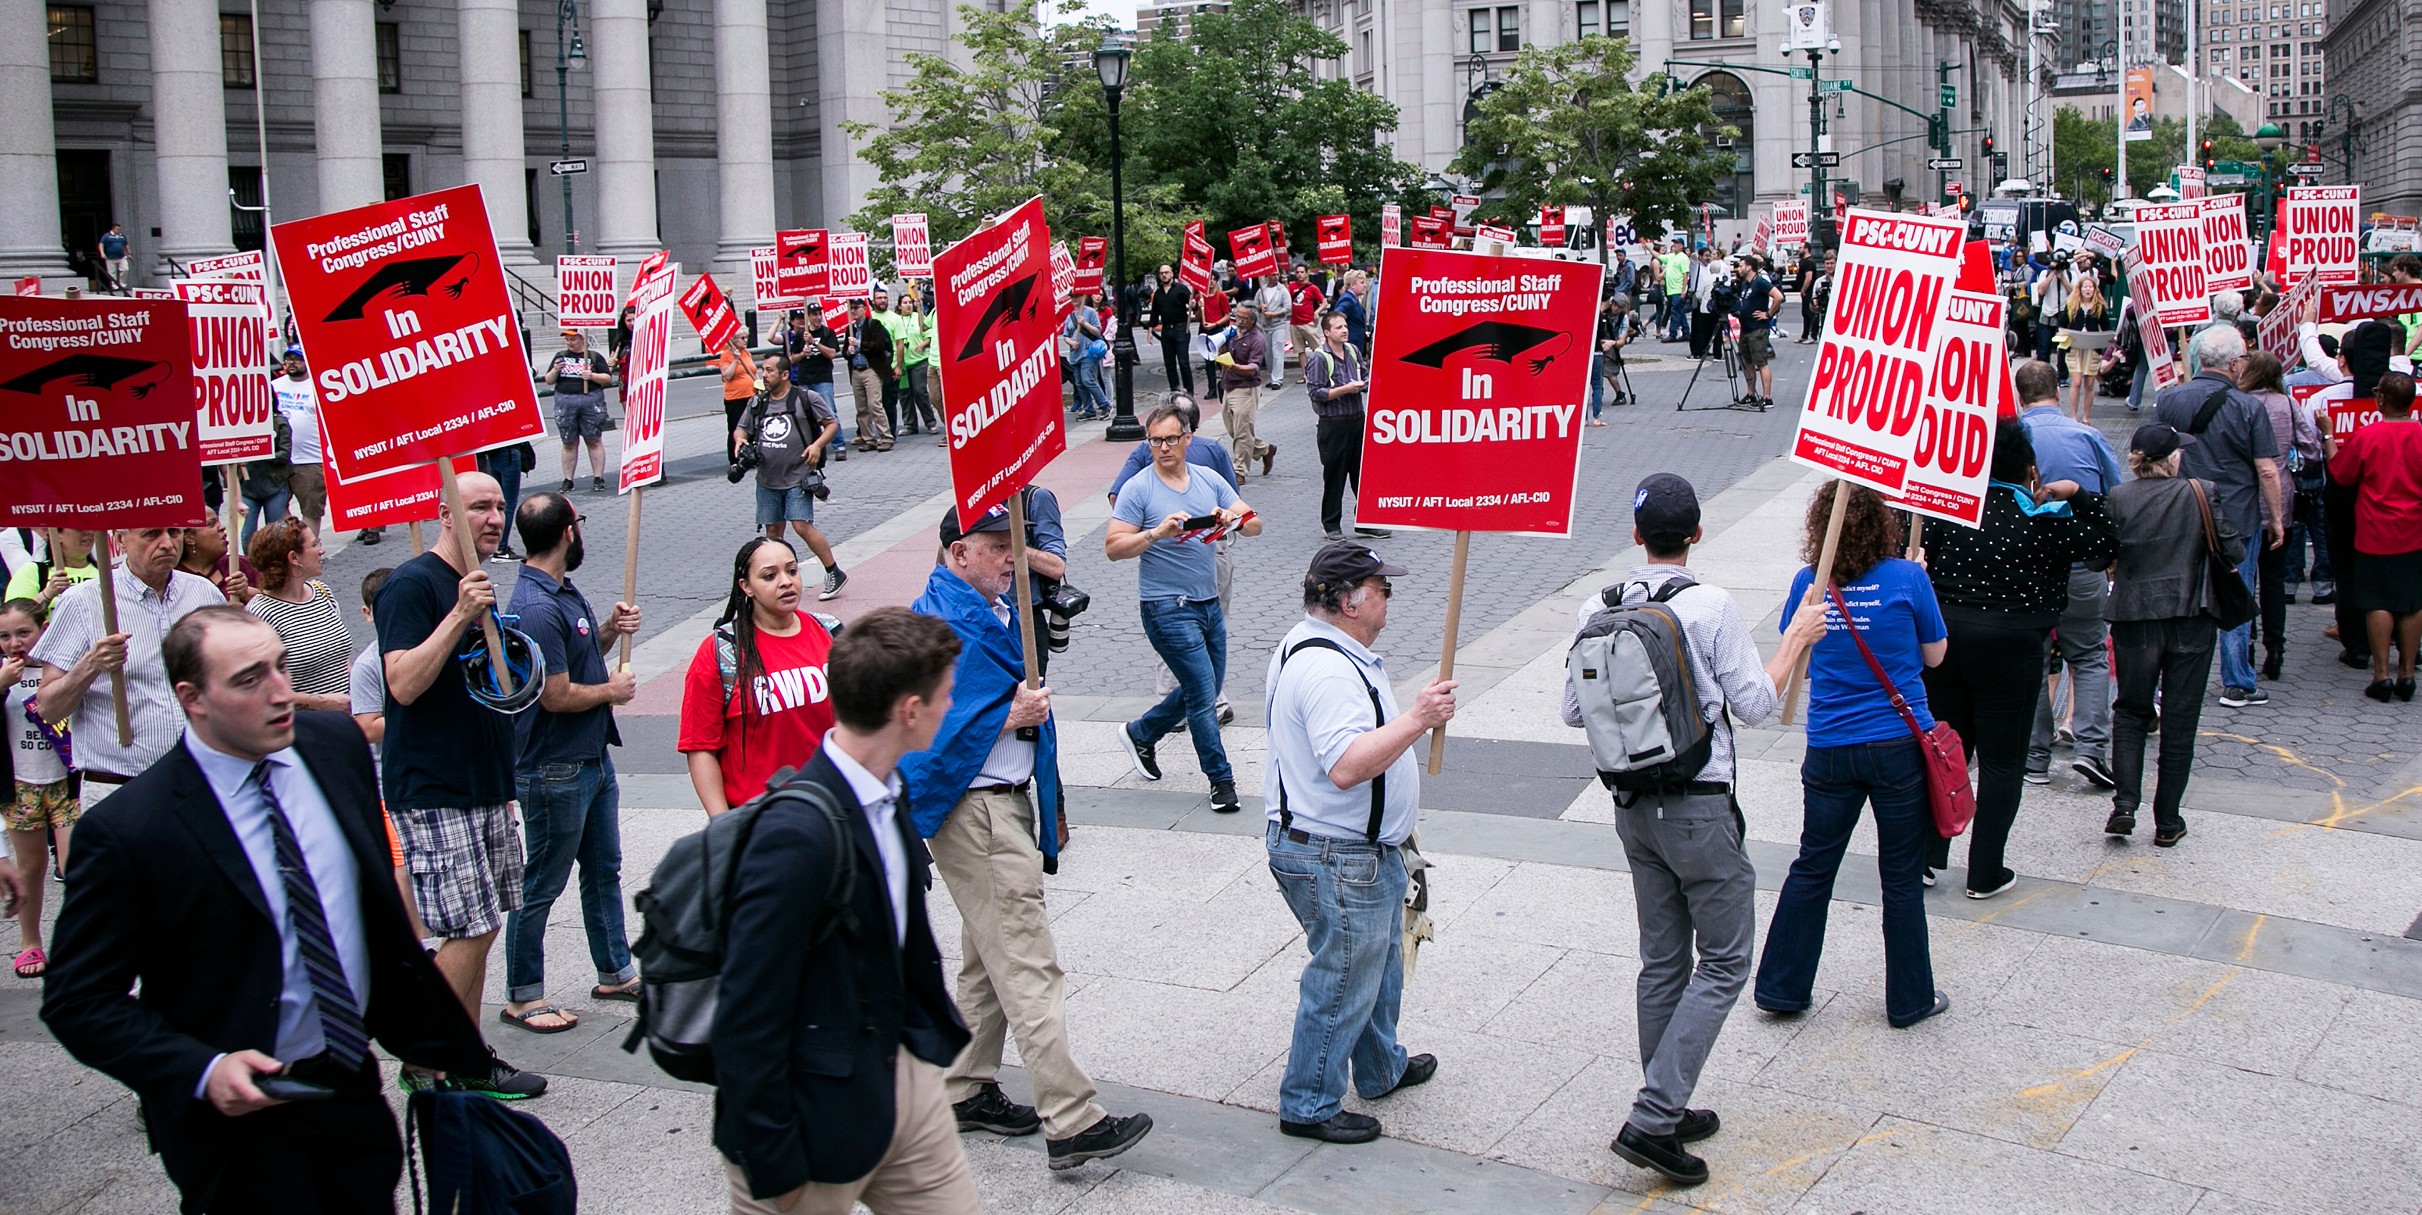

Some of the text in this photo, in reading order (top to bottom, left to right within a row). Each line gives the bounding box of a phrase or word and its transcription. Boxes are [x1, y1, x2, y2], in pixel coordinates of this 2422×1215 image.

[1790, 68, 1806, 78] CENTRE
[1821, 81, 1841, 91] DUANE
[2201, 197, 2238, 210] C-CUNY
[2294, 189, 2353, 200] PSC-CUNY
[1776, 209, 1804, 222] UNION
[2140, 206, 2196, 220] PSC-CUNY
[2292, 206, 2354, 235] UNION
[306, 204, 450, 260] Professional Staff
[829, 235, 862, 243] SC-CUNY
[896, 227, 926, 246] UNION
[1776, 222, 1806, 235] PROUD
[1852, 218, 1955, 255] PSC-CUNY
[1984, 224, 2002, 239] NEWS
[2091, 231, 2120, 248] UCATS
[2202, 213, 2242, 245] NION
[322, 223, 446, 274] Congress/CUNY
[950, 219, 1030, 292] Professional Staff
[1320, 239, 1350, 250] SOLIDARITY
[1412, 241, 1445, 250] SOLIDARITY
[2140, 227, 2200, 265] UNION
[2290, 236, 2356, 265] PROUD
[194, 254, 256, 273] PSC-CUNY
[563, 258, 612, 266] PSC-CUNY
[798, 256, 807, 265] In
[830, 246, 865, 266] NION
[898, 248, 930, 266] PROUD
[1050, 252, 1072, 276] NION
[1236, 248, 1272, 266] SOLIDARITY
[2205, 244, 2247, 275] ROUD
[562, 271, 613, 291] UNION
[779, 263, 828, 278] SOLIDARITY
[832, 267, 868, 286] ROUD
[958, 241, 1030, 308] Congress/CUNY
[186, 285, 262, 304] PSC-CUNY
[1410, 274, 1562, 294] Professional Staff
[560, 294, 615, 314] PROUD
[704, 307, 714, 317] In
[825, 303, 847, 320] SOLIDA
[1419, 294, 1552, 316] Congress/CUNY
[1834, 262, 1944, 353] UNION
[0, 311, 150, 333] Professional Staff
[384, 308, 422, 340] In
[700, 300, 728, 339] SOLIDARITY
[9, 328, 143, 351] Congress/CUNY
[189, 316, 265, 370] UNION
[320, 314, 510, 403] SOLIDARITY
[995, 338, 1016, 372] In
[1928, 335, 1992, 408] ION
[951, 332, 1056, 450] SOLIDARITY
[1462, 367, 1493, 400] In
[1808, 341, 1924, 437] PROUD
[65, 395, 100, 422] In
[194, 374, 269, 427] PROUD
[624, 376, 663, 452] PROUD
[1372, 404, 1576, 444] SOLIDARITY
[2335, 412, 2355, 434] IN
[354, 399, 516, 461] NYSUT AFT Local 2334 AFL-CIO
[200, 442, 224, 450] ofessional
[1804, 432, 1835, 450] Professional
[1846, 446, 1878, 462] Congress
[1882, 458, 1901, 470] CUNY
[1914, 404, 1988, 479] OUD
[1814, 446, 1826, 456] AFT
[1826, 450, 1838, 460] Local
[1854, 461, 1870, 471] AFL
[1871, 464, 1884, 475] CIO
[967, 484, 987, 510] NYSUT
[991, 470, 1004, 488] AFT
[1005, 457, 1022, 477] Local
[11, 494, 184, 514] NYSUT AFT Local 2334 AFL-CIO
[346, 490, 434, 519] NYSUT AFT Local 2334
[1378, 492, 1550, 508] NYSUT AFT Local 2334 AFL-CIO
[1920, 486, 1952, 500] Congress
[1956, 496, 1975, 506] CUNY
[1932, 498, 1946, 507] AFL
[1947, 502, 1960, 510] CIO
[1857, 584, 1879, 592] myself?
[754, 664, 829, 716] RWD
[20, 740, 34, 749] SO
